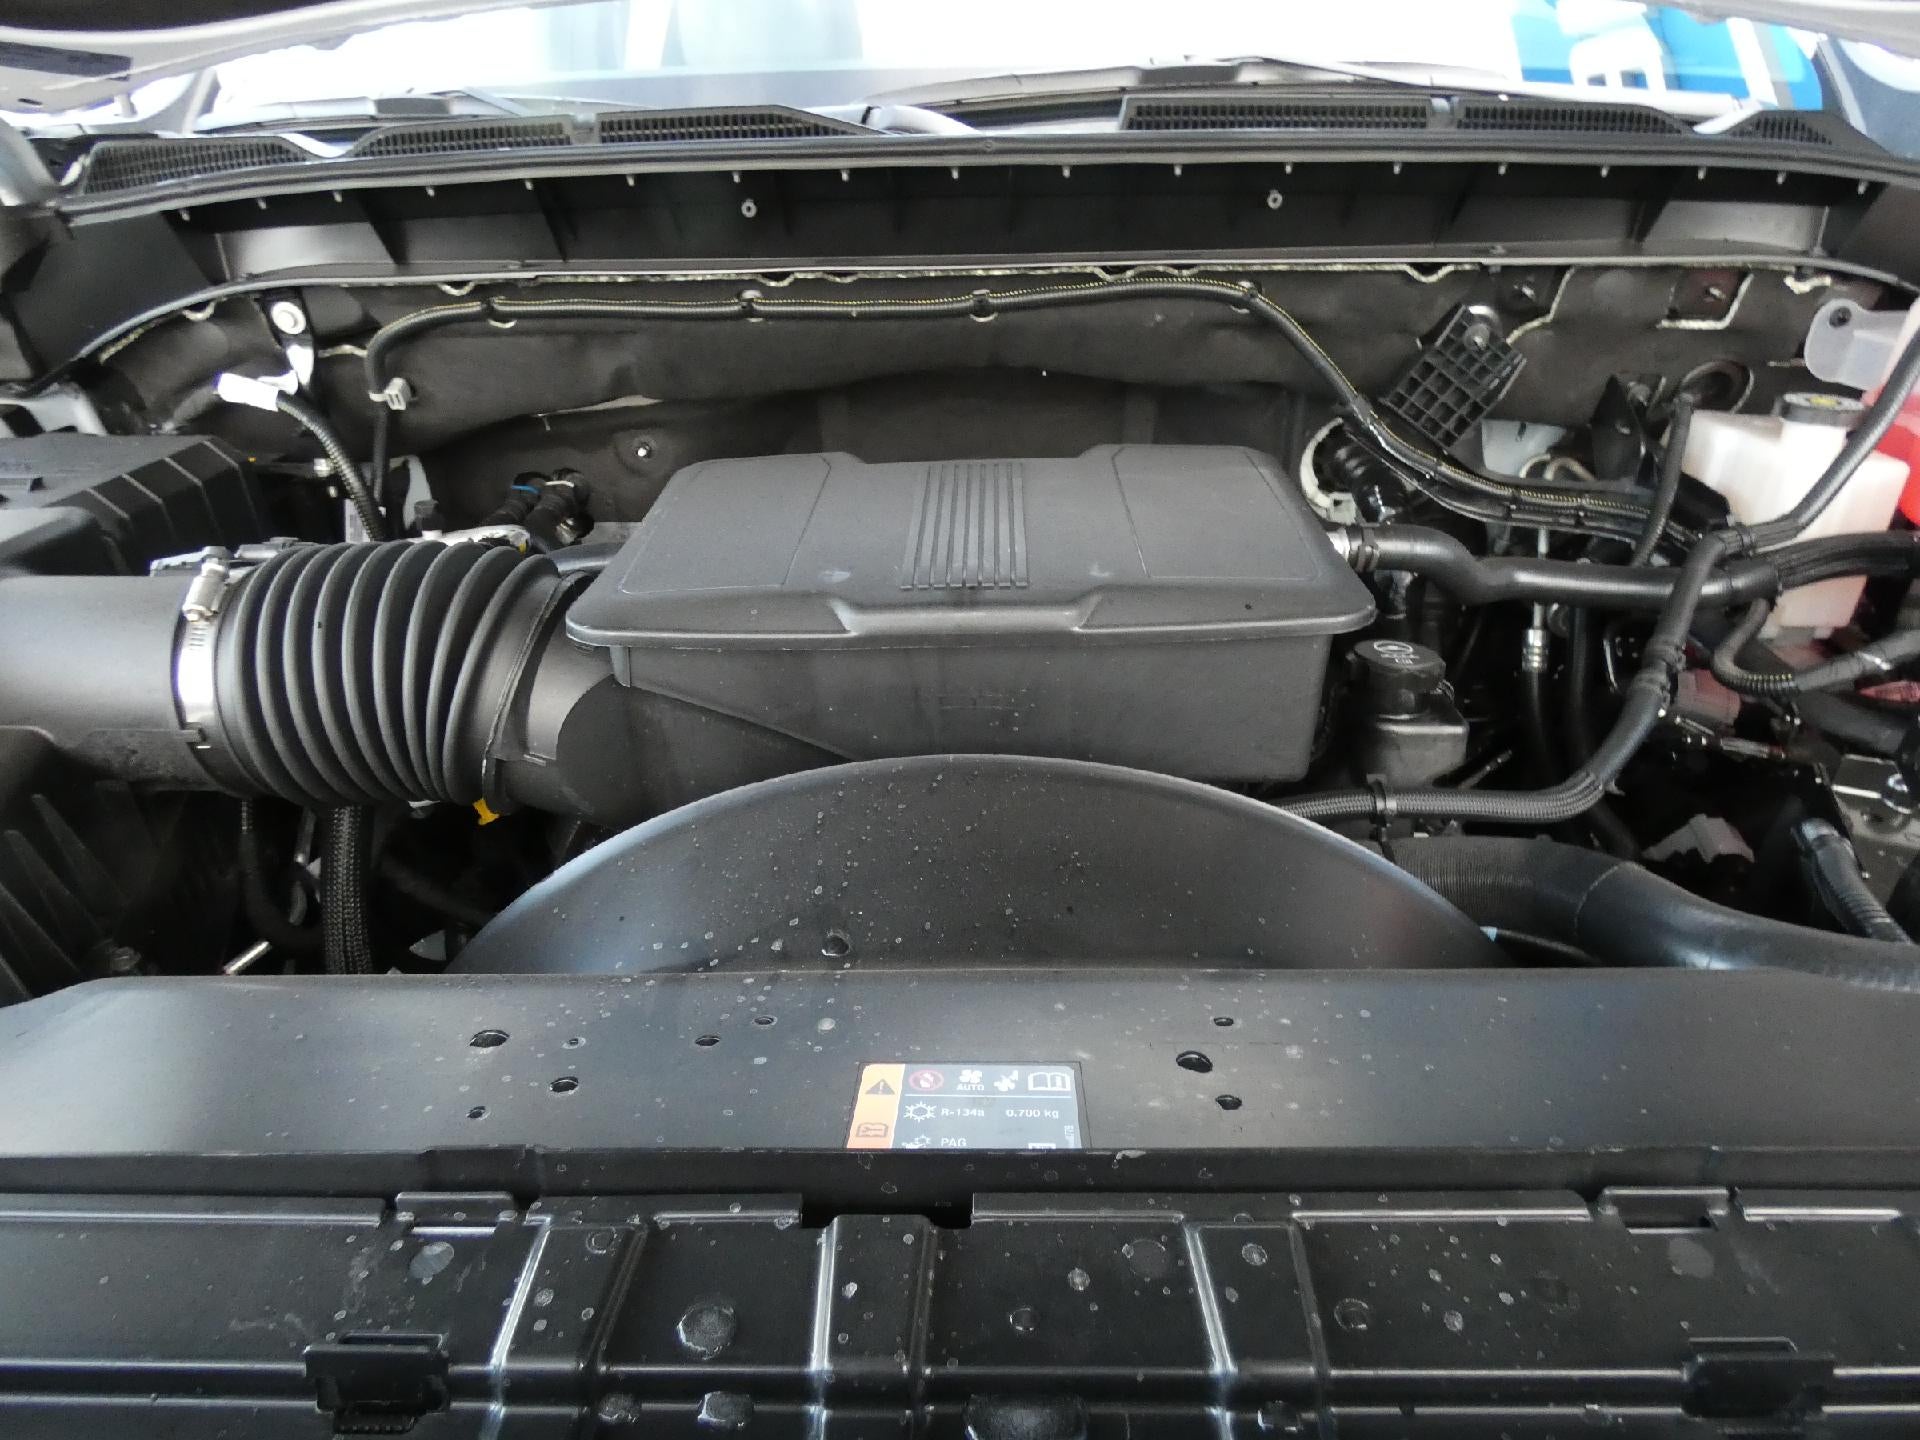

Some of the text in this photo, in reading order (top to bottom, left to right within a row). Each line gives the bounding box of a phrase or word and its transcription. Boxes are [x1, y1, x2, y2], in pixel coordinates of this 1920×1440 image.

[941, 1108, 1059, 1119] R-134a 0.700 kg
[941, 1137, 967, 1147] PAG
